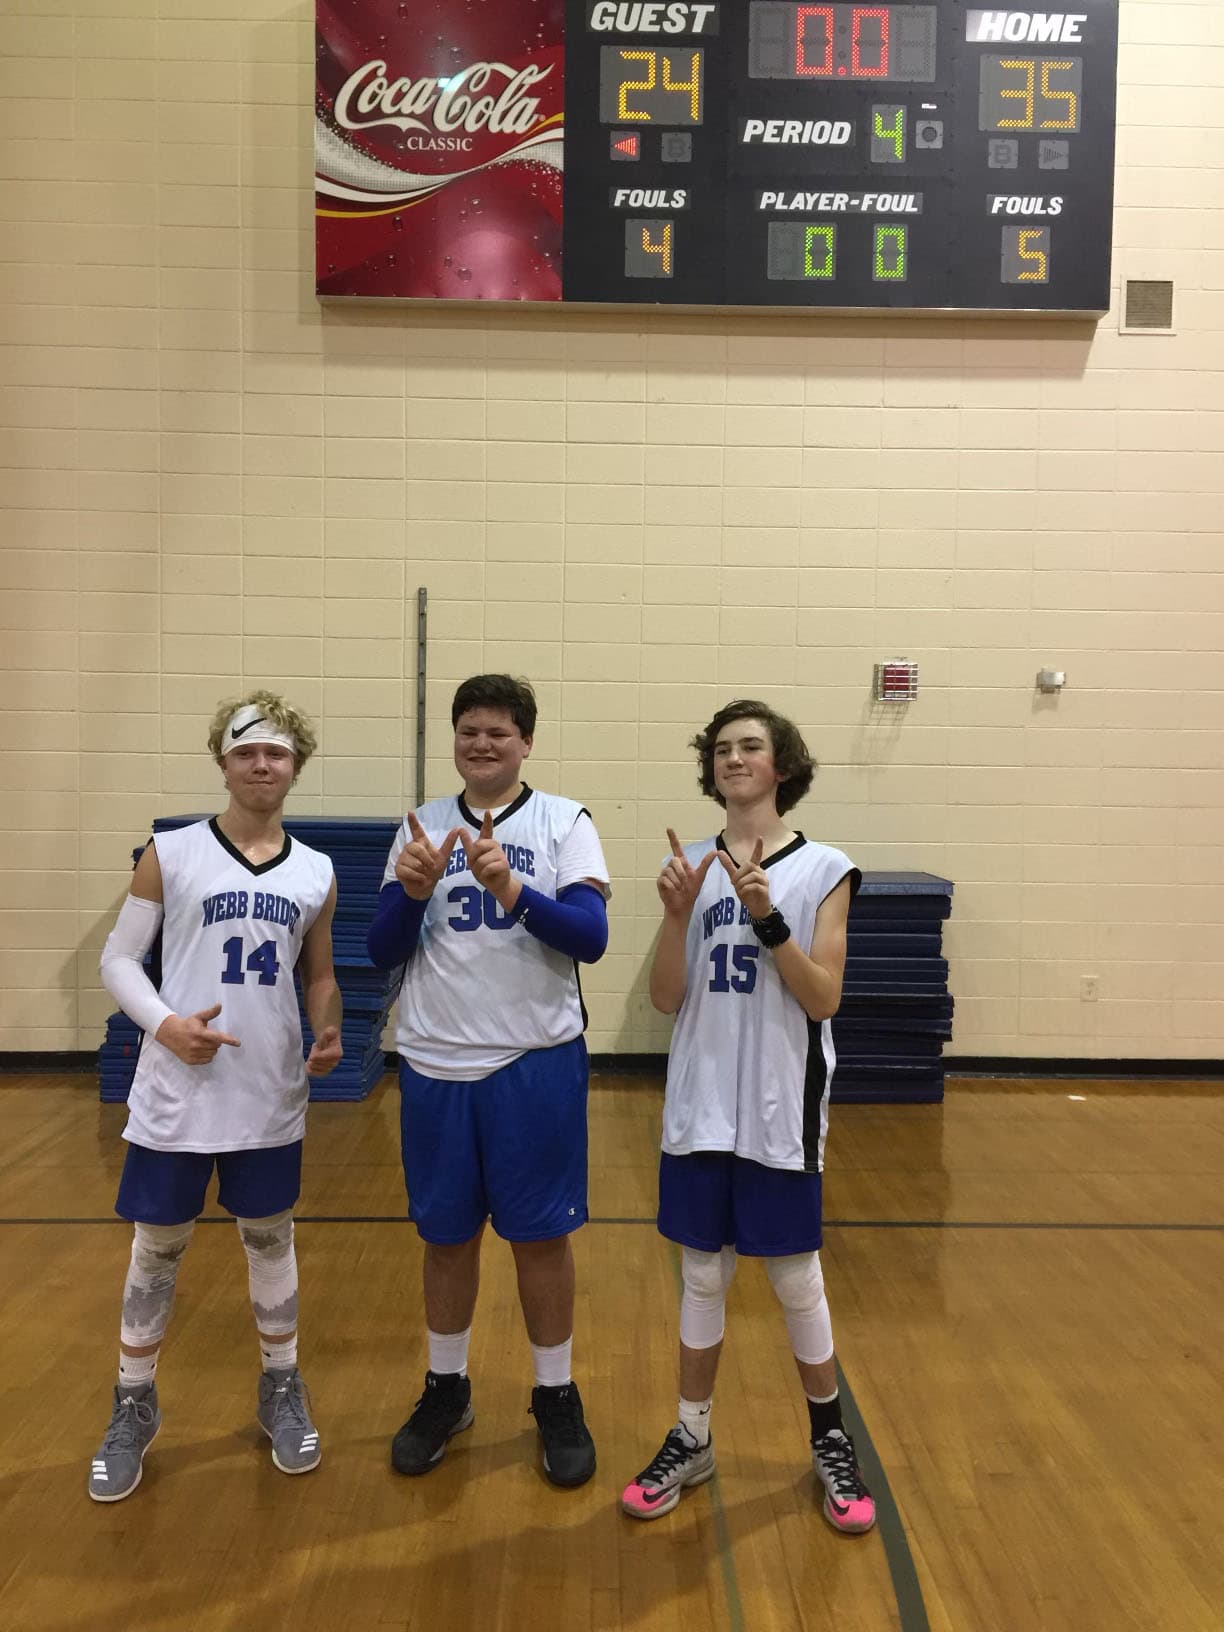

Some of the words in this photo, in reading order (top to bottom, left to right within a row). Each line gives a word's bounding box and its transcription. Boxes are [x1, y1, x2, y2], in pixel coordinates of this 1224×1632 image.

[590, 2, 716, 34] GUEST
[976, 12, 1087, 43] HOME
[618, 50, 700, 121] 24
[997, 60, 1077, 129] 35
[407, 136, 473, 152] CLASSIC
[743, 119, 852, 145] PERIOD
[874, 109, 903, 160] 4
[614, 189, 687, 209] FOULS
[759, 192, 919, 213] PLAYER-FOUL
[991, 196, 1064, 216] FOULS
[641, 223, 671, 274] 4
[804, 226, 834, 277] 0
[875, 227, 904, 278] 0
[1018, 230, 1046, 280] 5
[446, 848, 471, 877] EB
[501, 843, 535, 877] DGE
[202, 891, 248, 928] WEBB
[447, 885, 517, 932] 30
[221, 936, 280, 986] 14
[709, 943, 759, 994] 15
